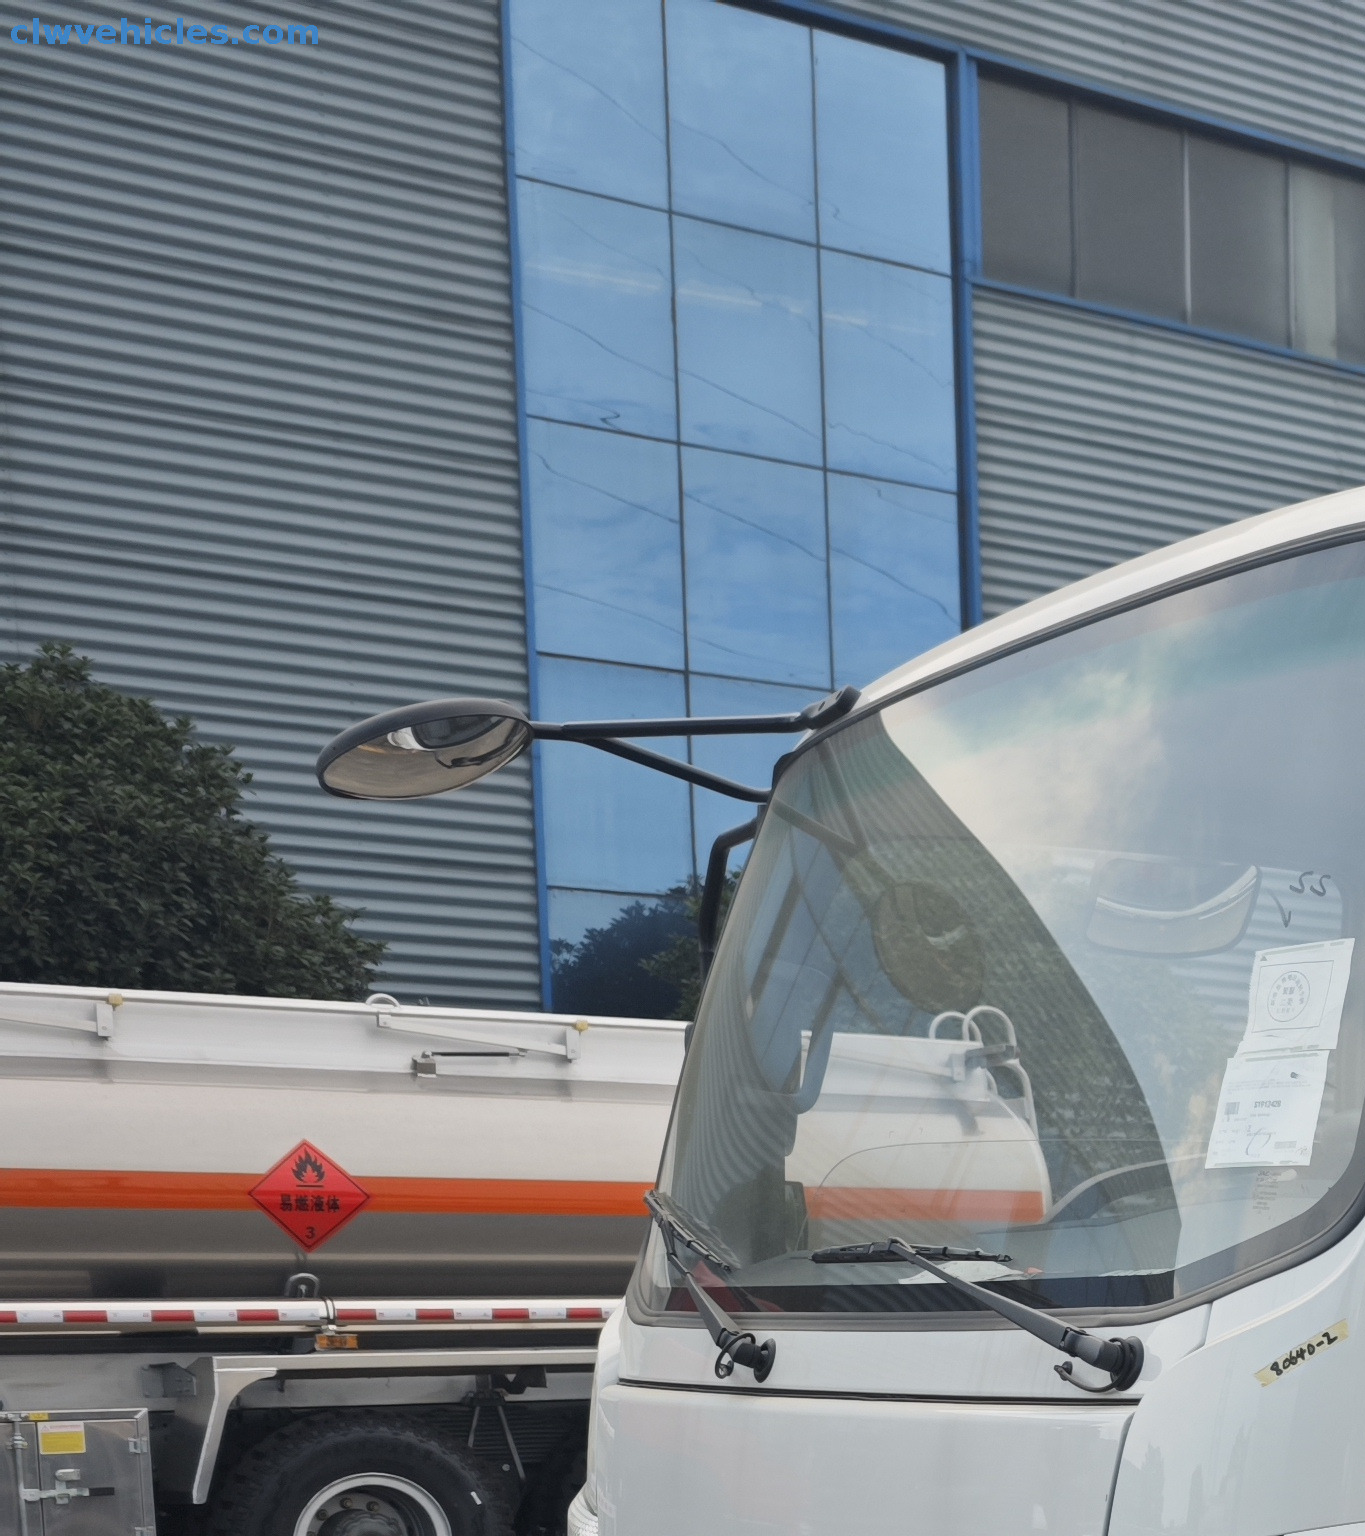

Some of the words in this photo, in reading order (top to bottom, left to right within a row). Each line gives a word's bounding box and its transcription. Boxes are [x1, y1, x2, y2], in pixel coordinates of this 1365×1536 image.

[280, 1193, 340, 1213] 易燃液体
[304, 1225, 316, 1240] 3
[1269, 1331, 1338, 1377] 80640-2
